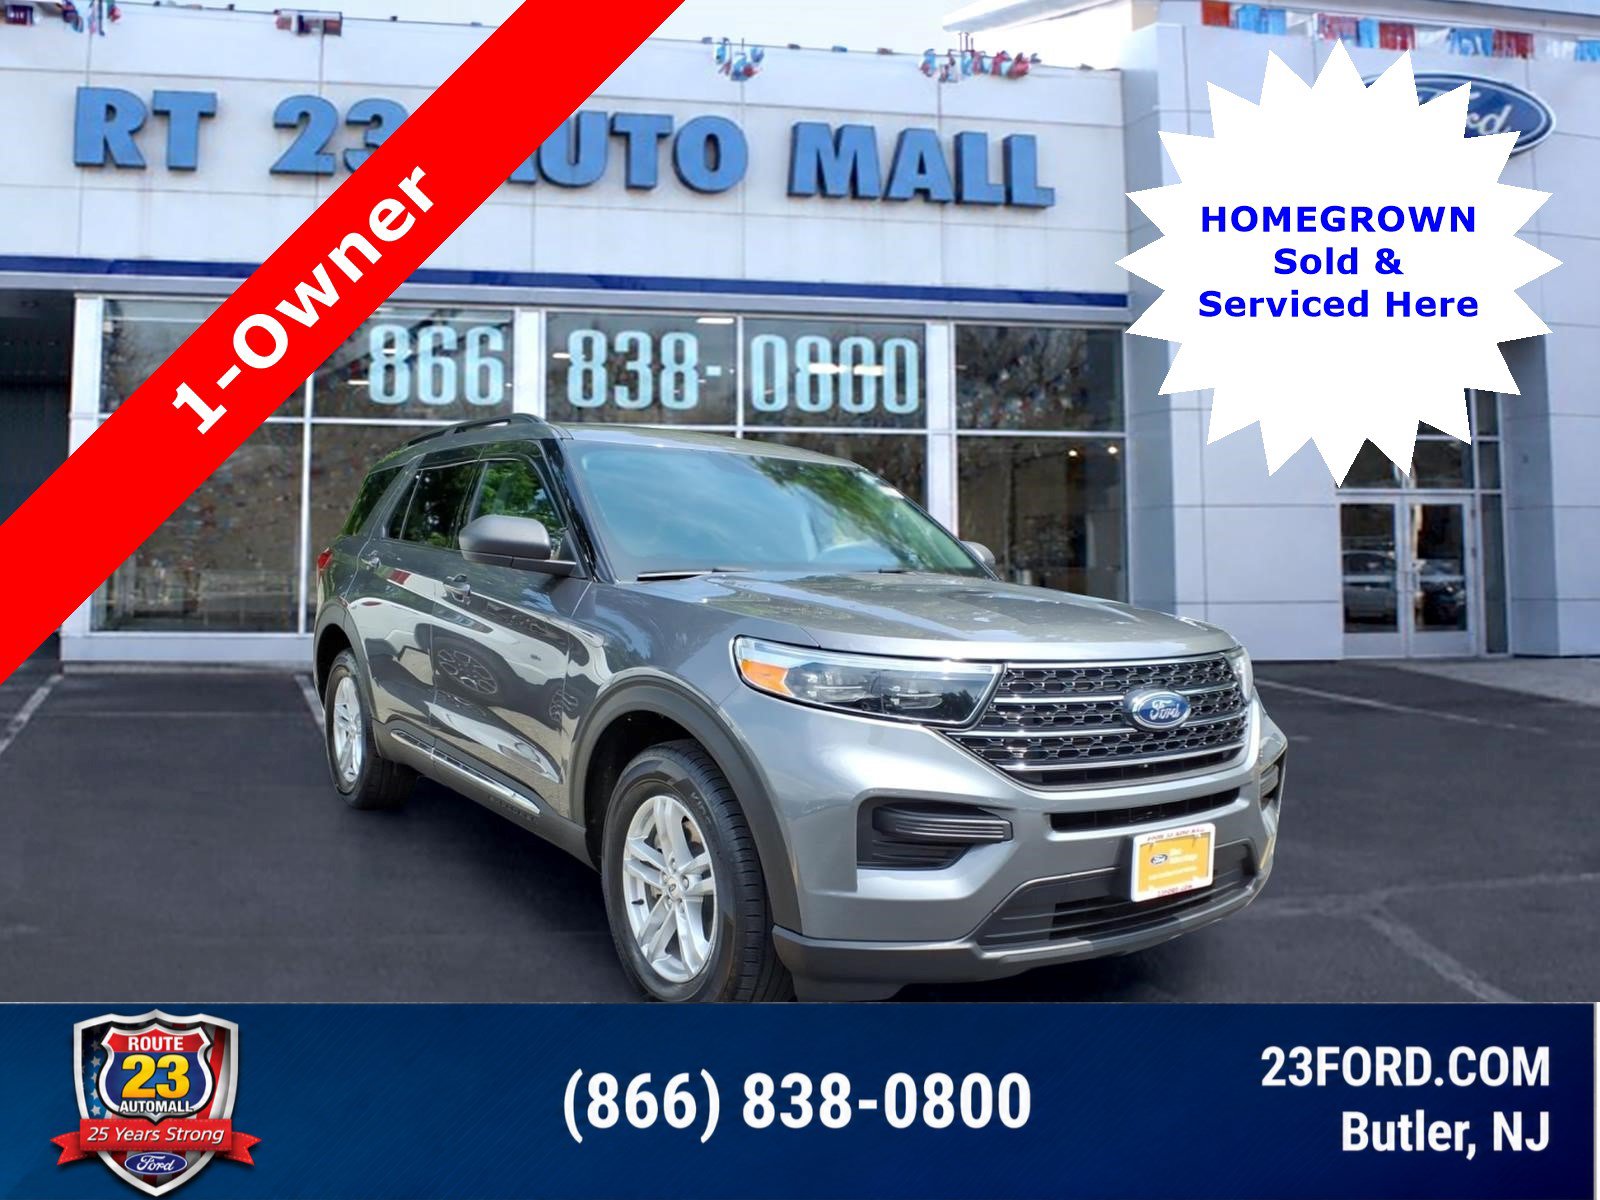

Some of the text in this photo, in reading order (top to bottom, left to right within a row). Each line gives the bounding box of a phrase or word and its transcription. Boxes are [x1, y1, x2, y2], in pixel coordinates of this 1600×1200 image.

[72, 85, 219, 171] RT
[509, 109, 751, 195] UTO
[786, 119, 1058, 208] MALL
[368, 324, 505, 405] 866
[1149, 699, 1181, 721] Ford
